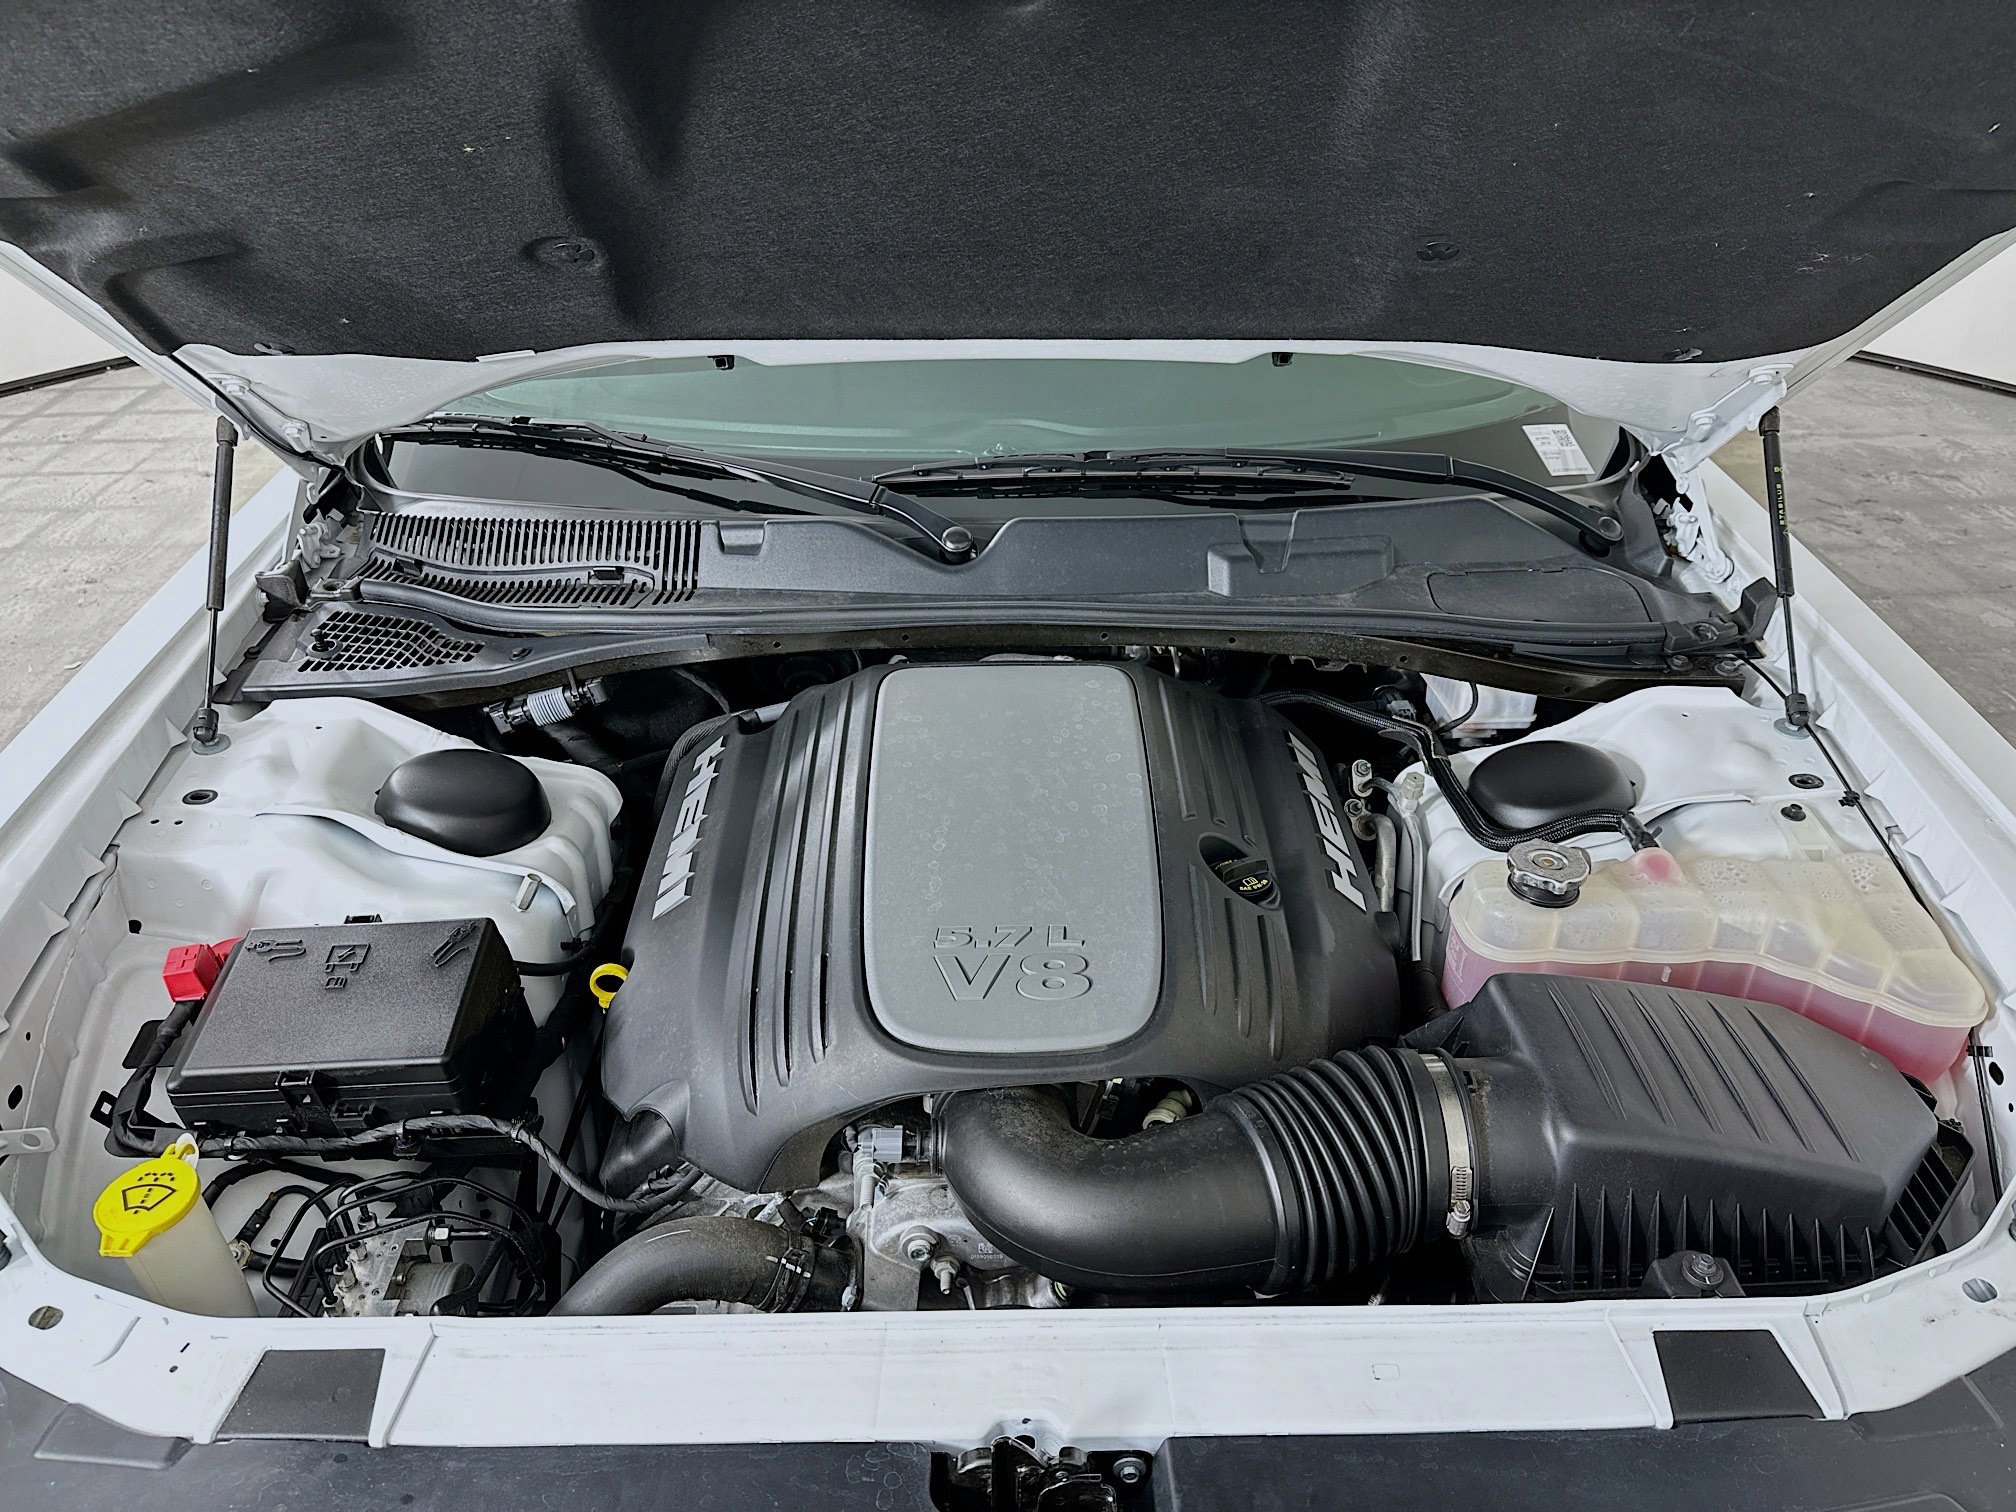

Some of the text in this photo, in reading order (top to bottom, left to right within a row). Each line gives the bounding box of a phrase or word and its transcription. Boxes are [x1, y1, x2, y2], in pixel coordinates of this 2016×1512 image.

[1776, 483, 1786, 526] STABILUS
[652, 735, 726, 921] HEMI
[1289, 731, 1367, 913] HEMI
[933, 924, 1085, 949] 5.7L
[933, 952, 1094, 1002] V8
